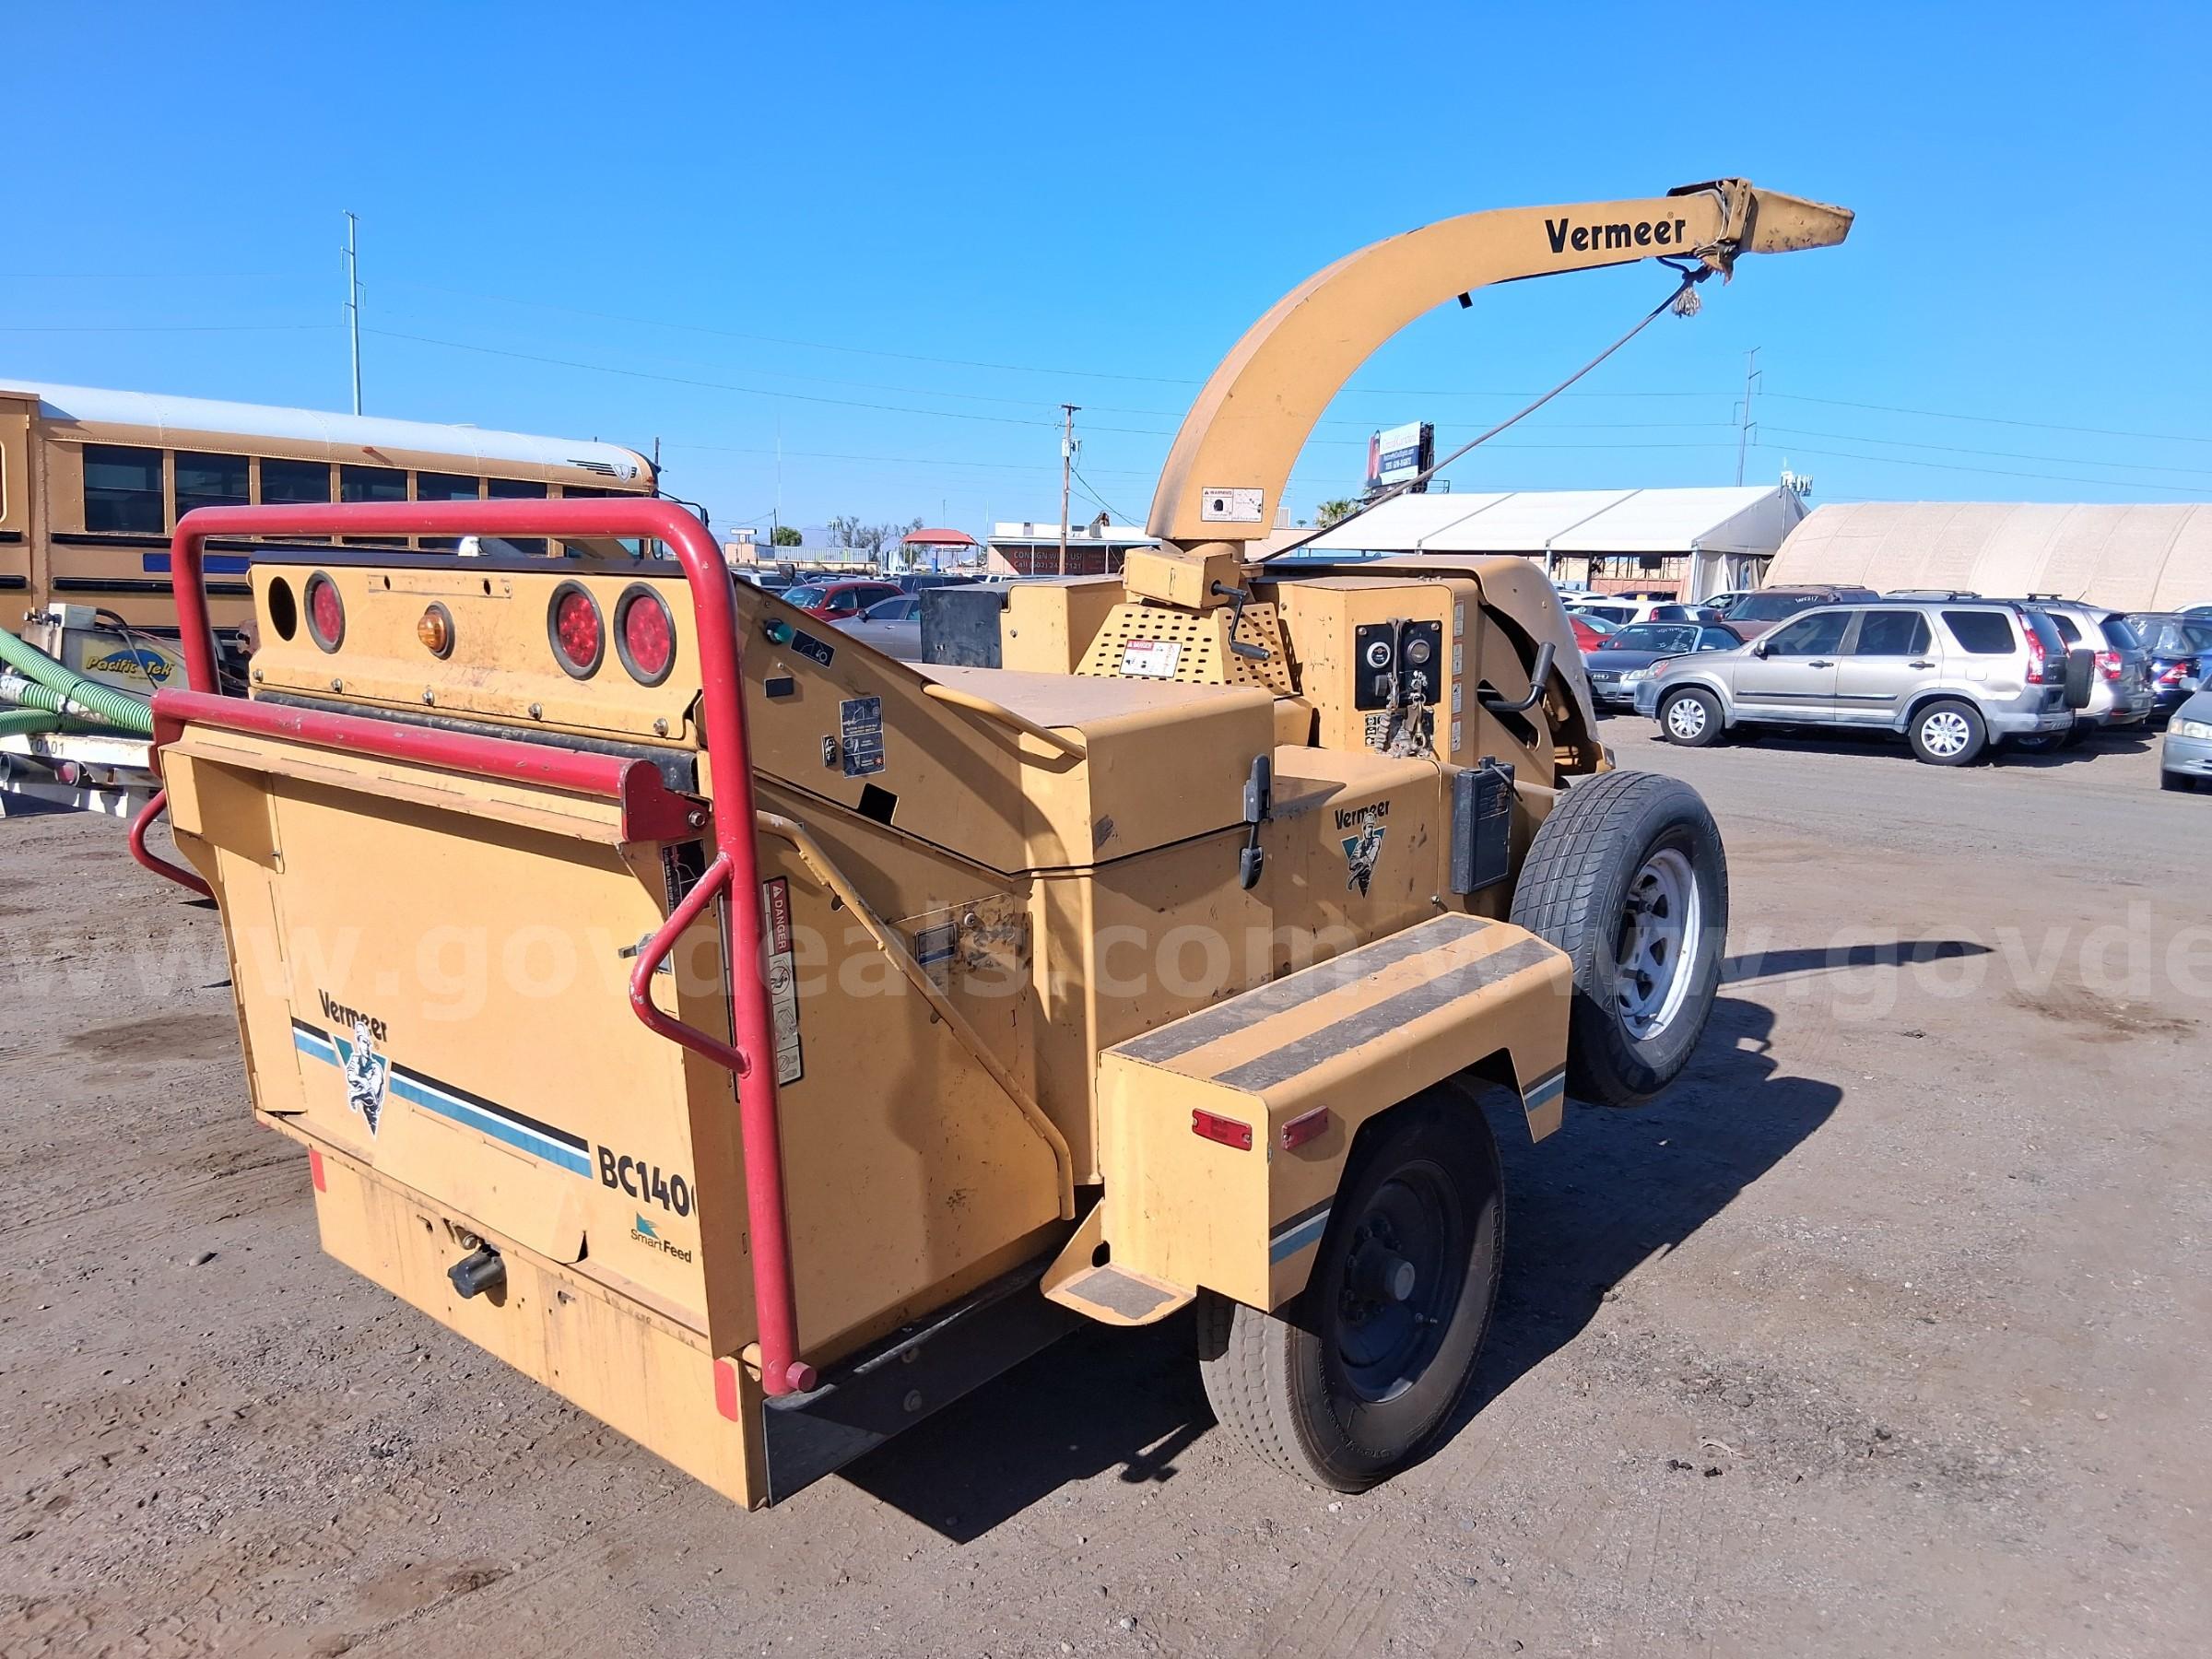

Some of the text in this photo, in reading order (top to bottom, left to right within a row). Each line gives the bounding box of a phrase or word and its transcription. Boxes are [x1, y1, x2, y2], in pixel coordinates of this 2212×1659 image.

[1545, 218, 1687, 254] Vermeer
[86, 655, 172, 677] Pacific Tek
[1335, 800, 1390, 830] Vermeer
[774, 899, 787, 949] DANGER
[318, 987, 387, 1043] Vermeer
[597, 1144, 697, 1218] BC140
